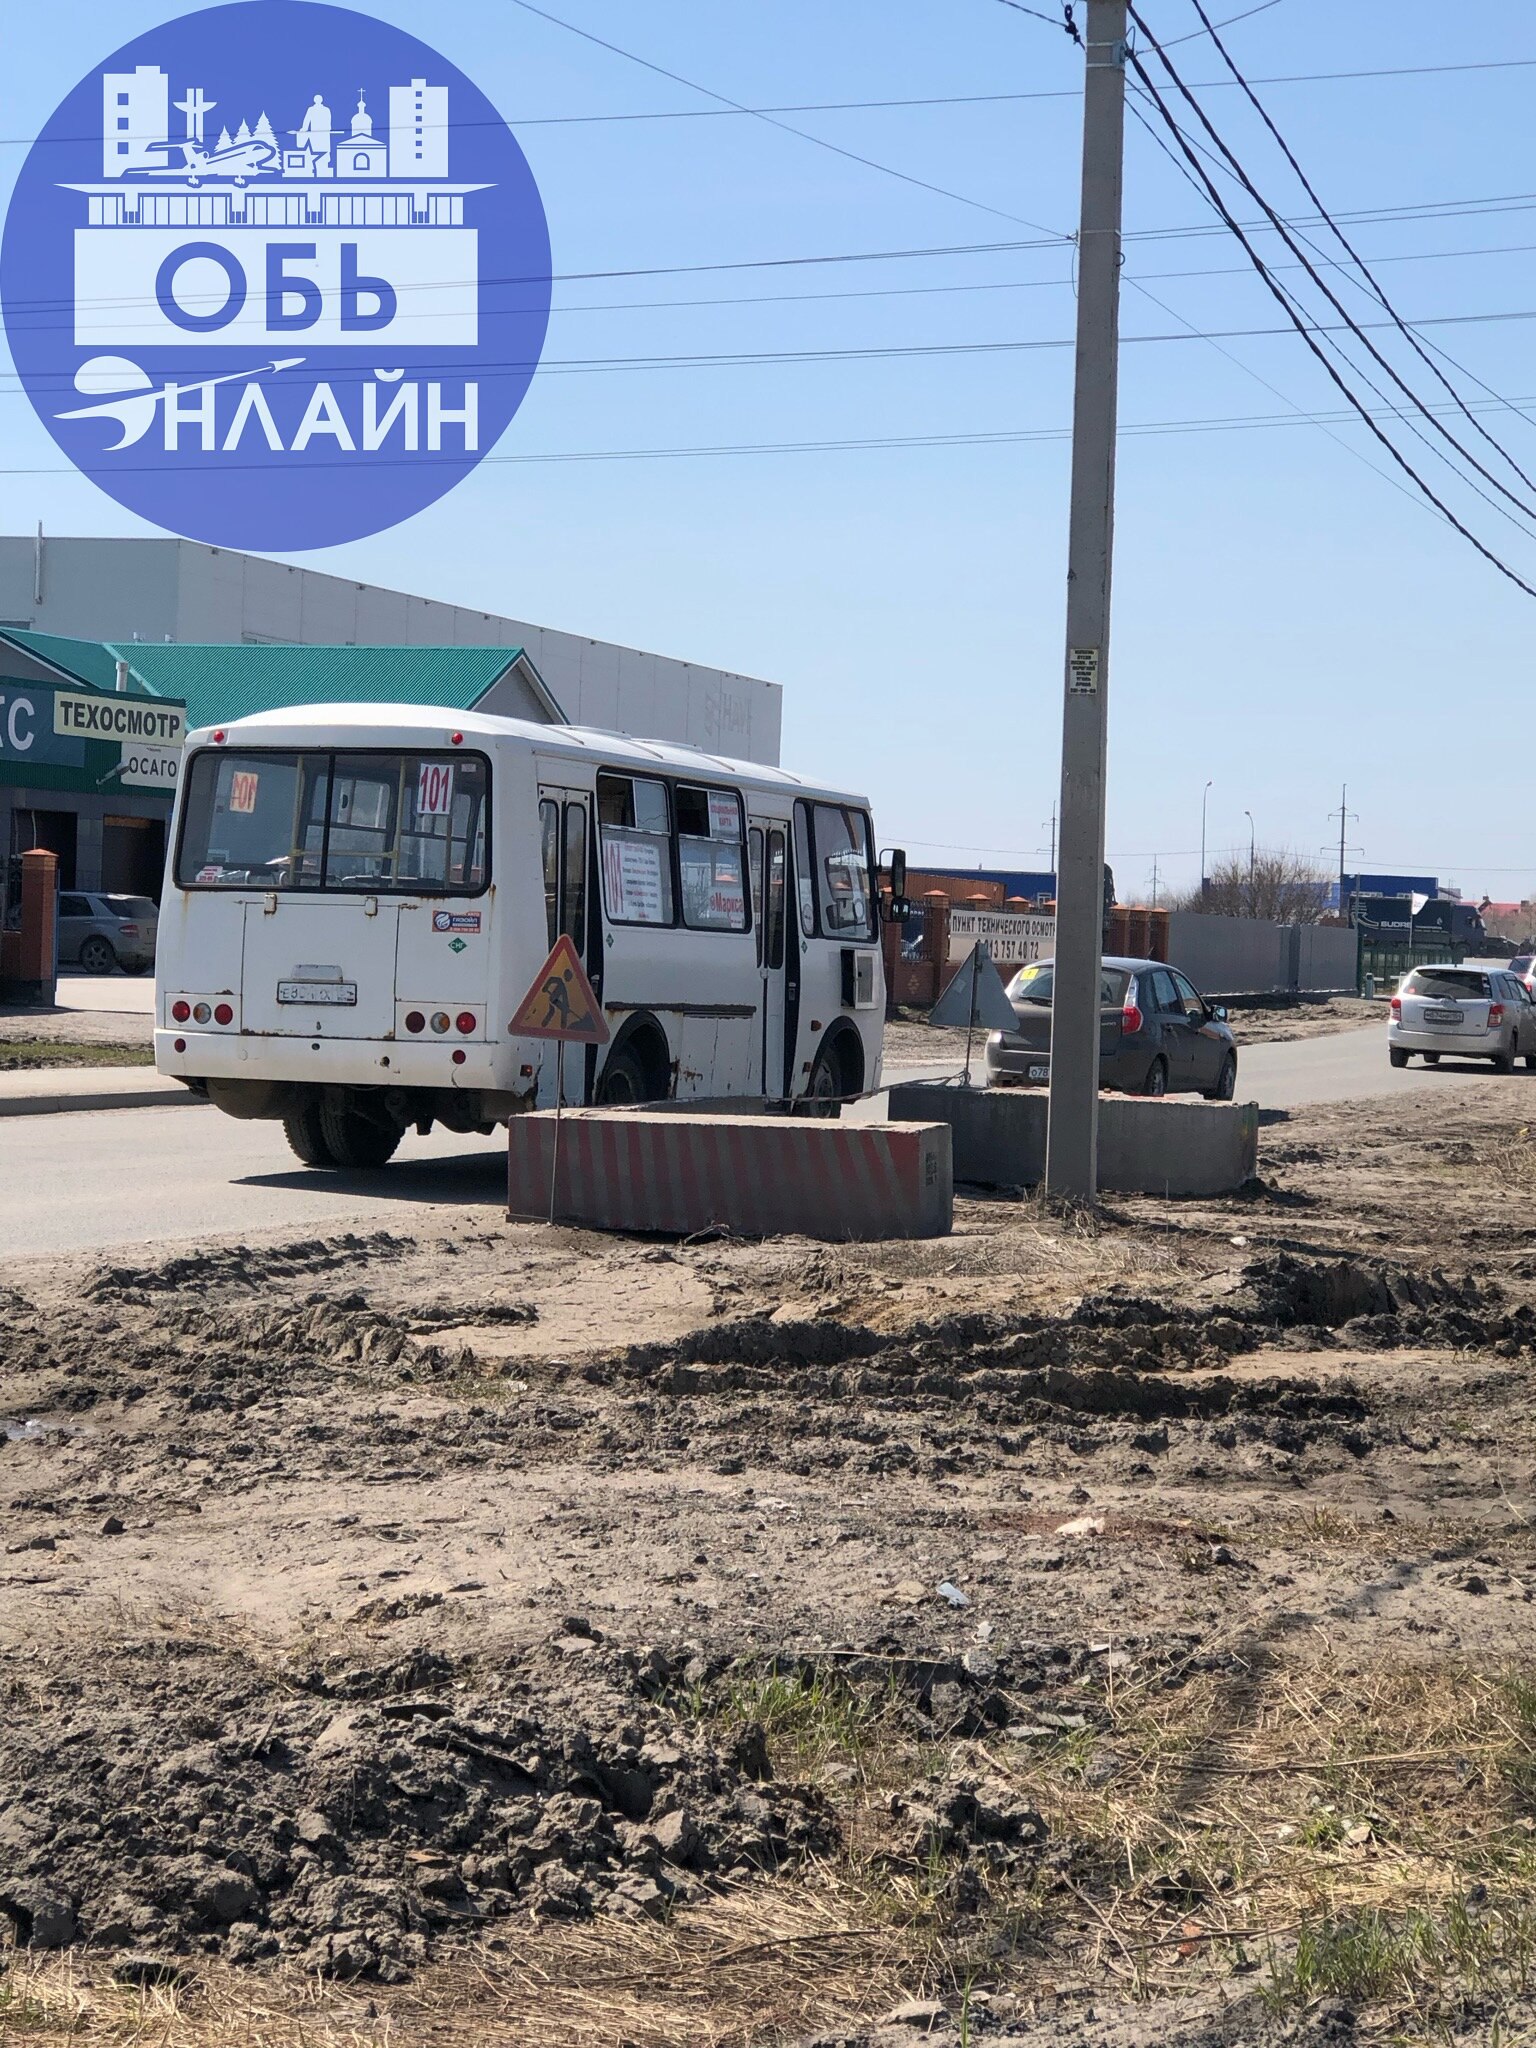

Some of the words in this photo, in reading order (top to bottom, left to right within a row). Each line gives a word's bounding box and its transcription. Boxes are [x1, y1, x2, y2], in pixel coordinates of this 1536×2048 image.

[0, 695, 35, 751] С
[60, 700, 180, 739] ТЕХОСМОТР
[129, 756, 177, 778] ОСАГО
[419, 766, 450, 812] 101
[952, 915, 976, 933] ПУНКТ
[977, 917, 1031, 935] ТЕХНИЧЕСКОГО
[1001, 940, 1016, 959] 757
[1018, 941, 1028, 959] 40
[1030, 941, 1039, 960] 72
